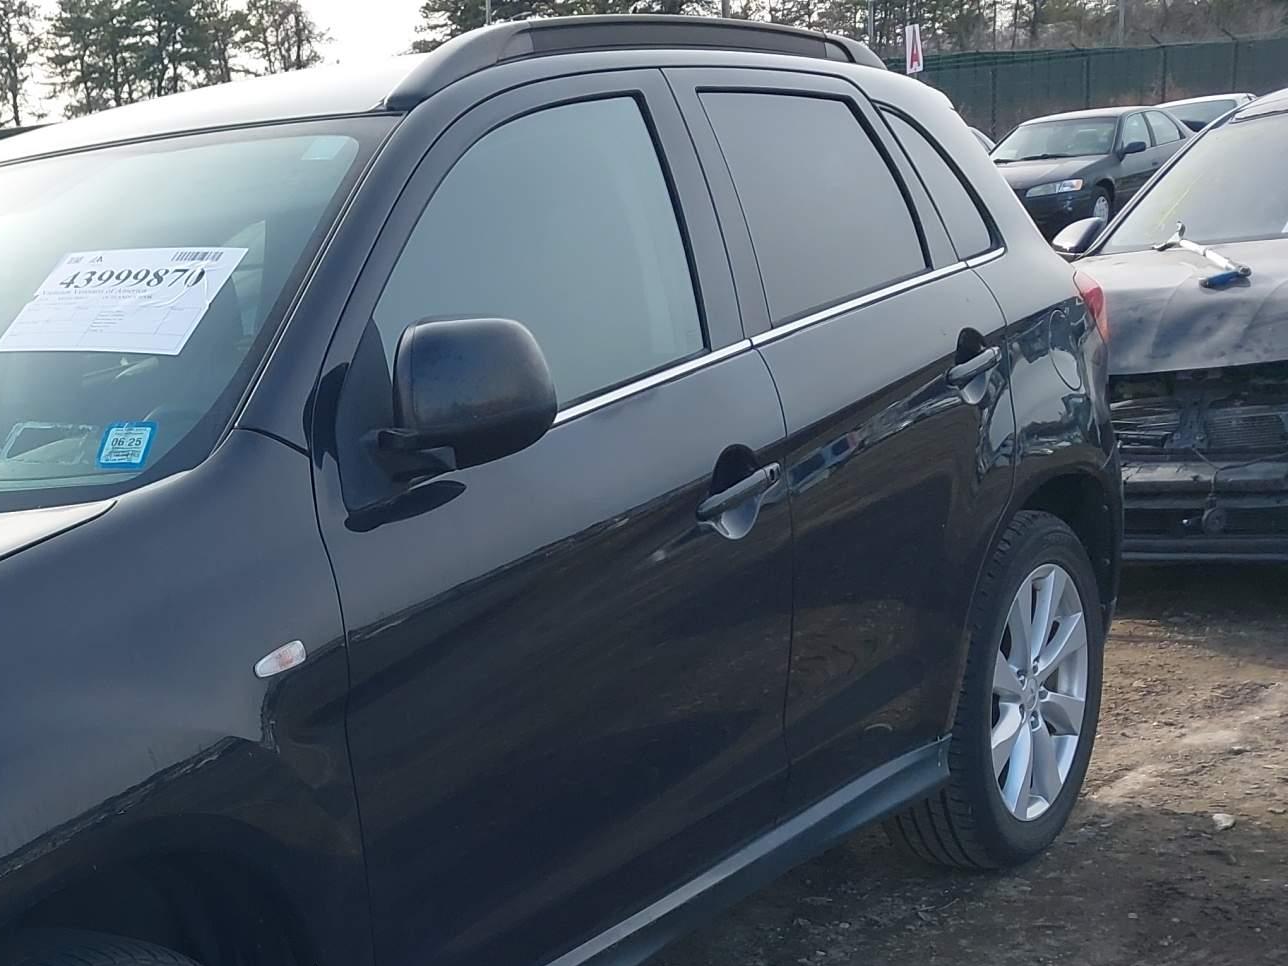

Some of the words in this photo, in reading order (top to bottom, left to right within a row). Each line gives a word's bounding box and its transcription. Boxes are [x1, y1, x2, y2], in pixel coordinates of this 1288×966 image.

[910, 25, 921, 69] A
[59, 267, 206, 288] 43999870
[111, 437, 125, 447] 06
[128, 437, 143, 447] 25
